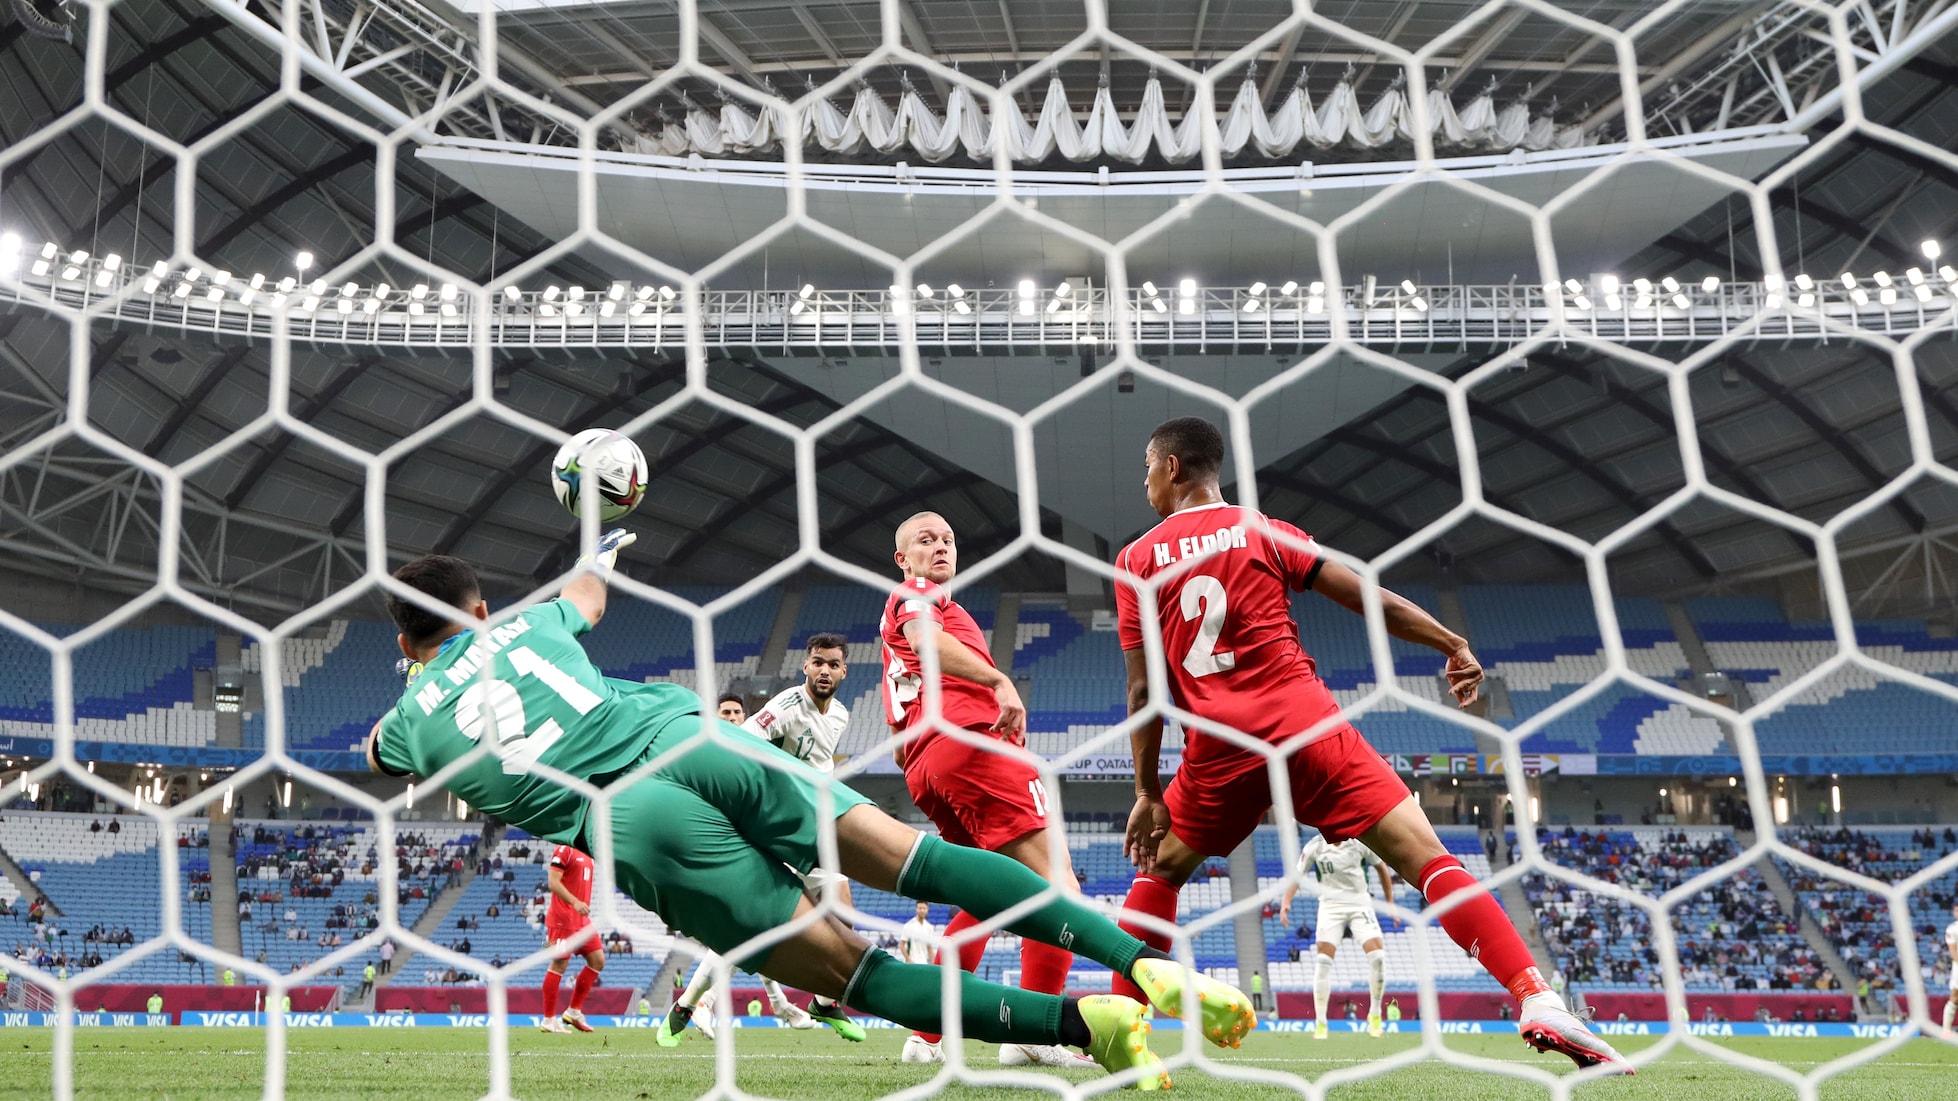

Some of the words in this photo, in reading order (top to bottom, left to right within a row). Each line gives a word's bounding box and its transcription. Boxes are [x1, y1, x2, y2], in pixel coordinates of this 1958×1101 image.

[1154, 543, 1177, 567] H.
[1179, 525, 1247, 560] ELDOR
[1180, 575, 1235, 678] 2
[414, 680, 452, 717] M.
[454, 646, 605, 775] 21
[795, 736, 815, 761] 12
[1320, 861, 1334, 874] 10
[3, 1013, 29, 1026] VISA
[42, 1013, 61, 1026] VIS
[77, 1013, 100, 1027] VISA
[112, 1014, 134, 1027] VISA
[146, 1014, 167, 1027] VISA
[198, 1013, 250, 1027] VISA
[283, 1014, 334, 1027] VISA
[364, 1015, 416, 1027] VISA
[1264, 1021, 1316, 1032] VISA
[1596, 1023, 1650, 1035] VISA
[1763, 1024, 1819, 1037] VISA
